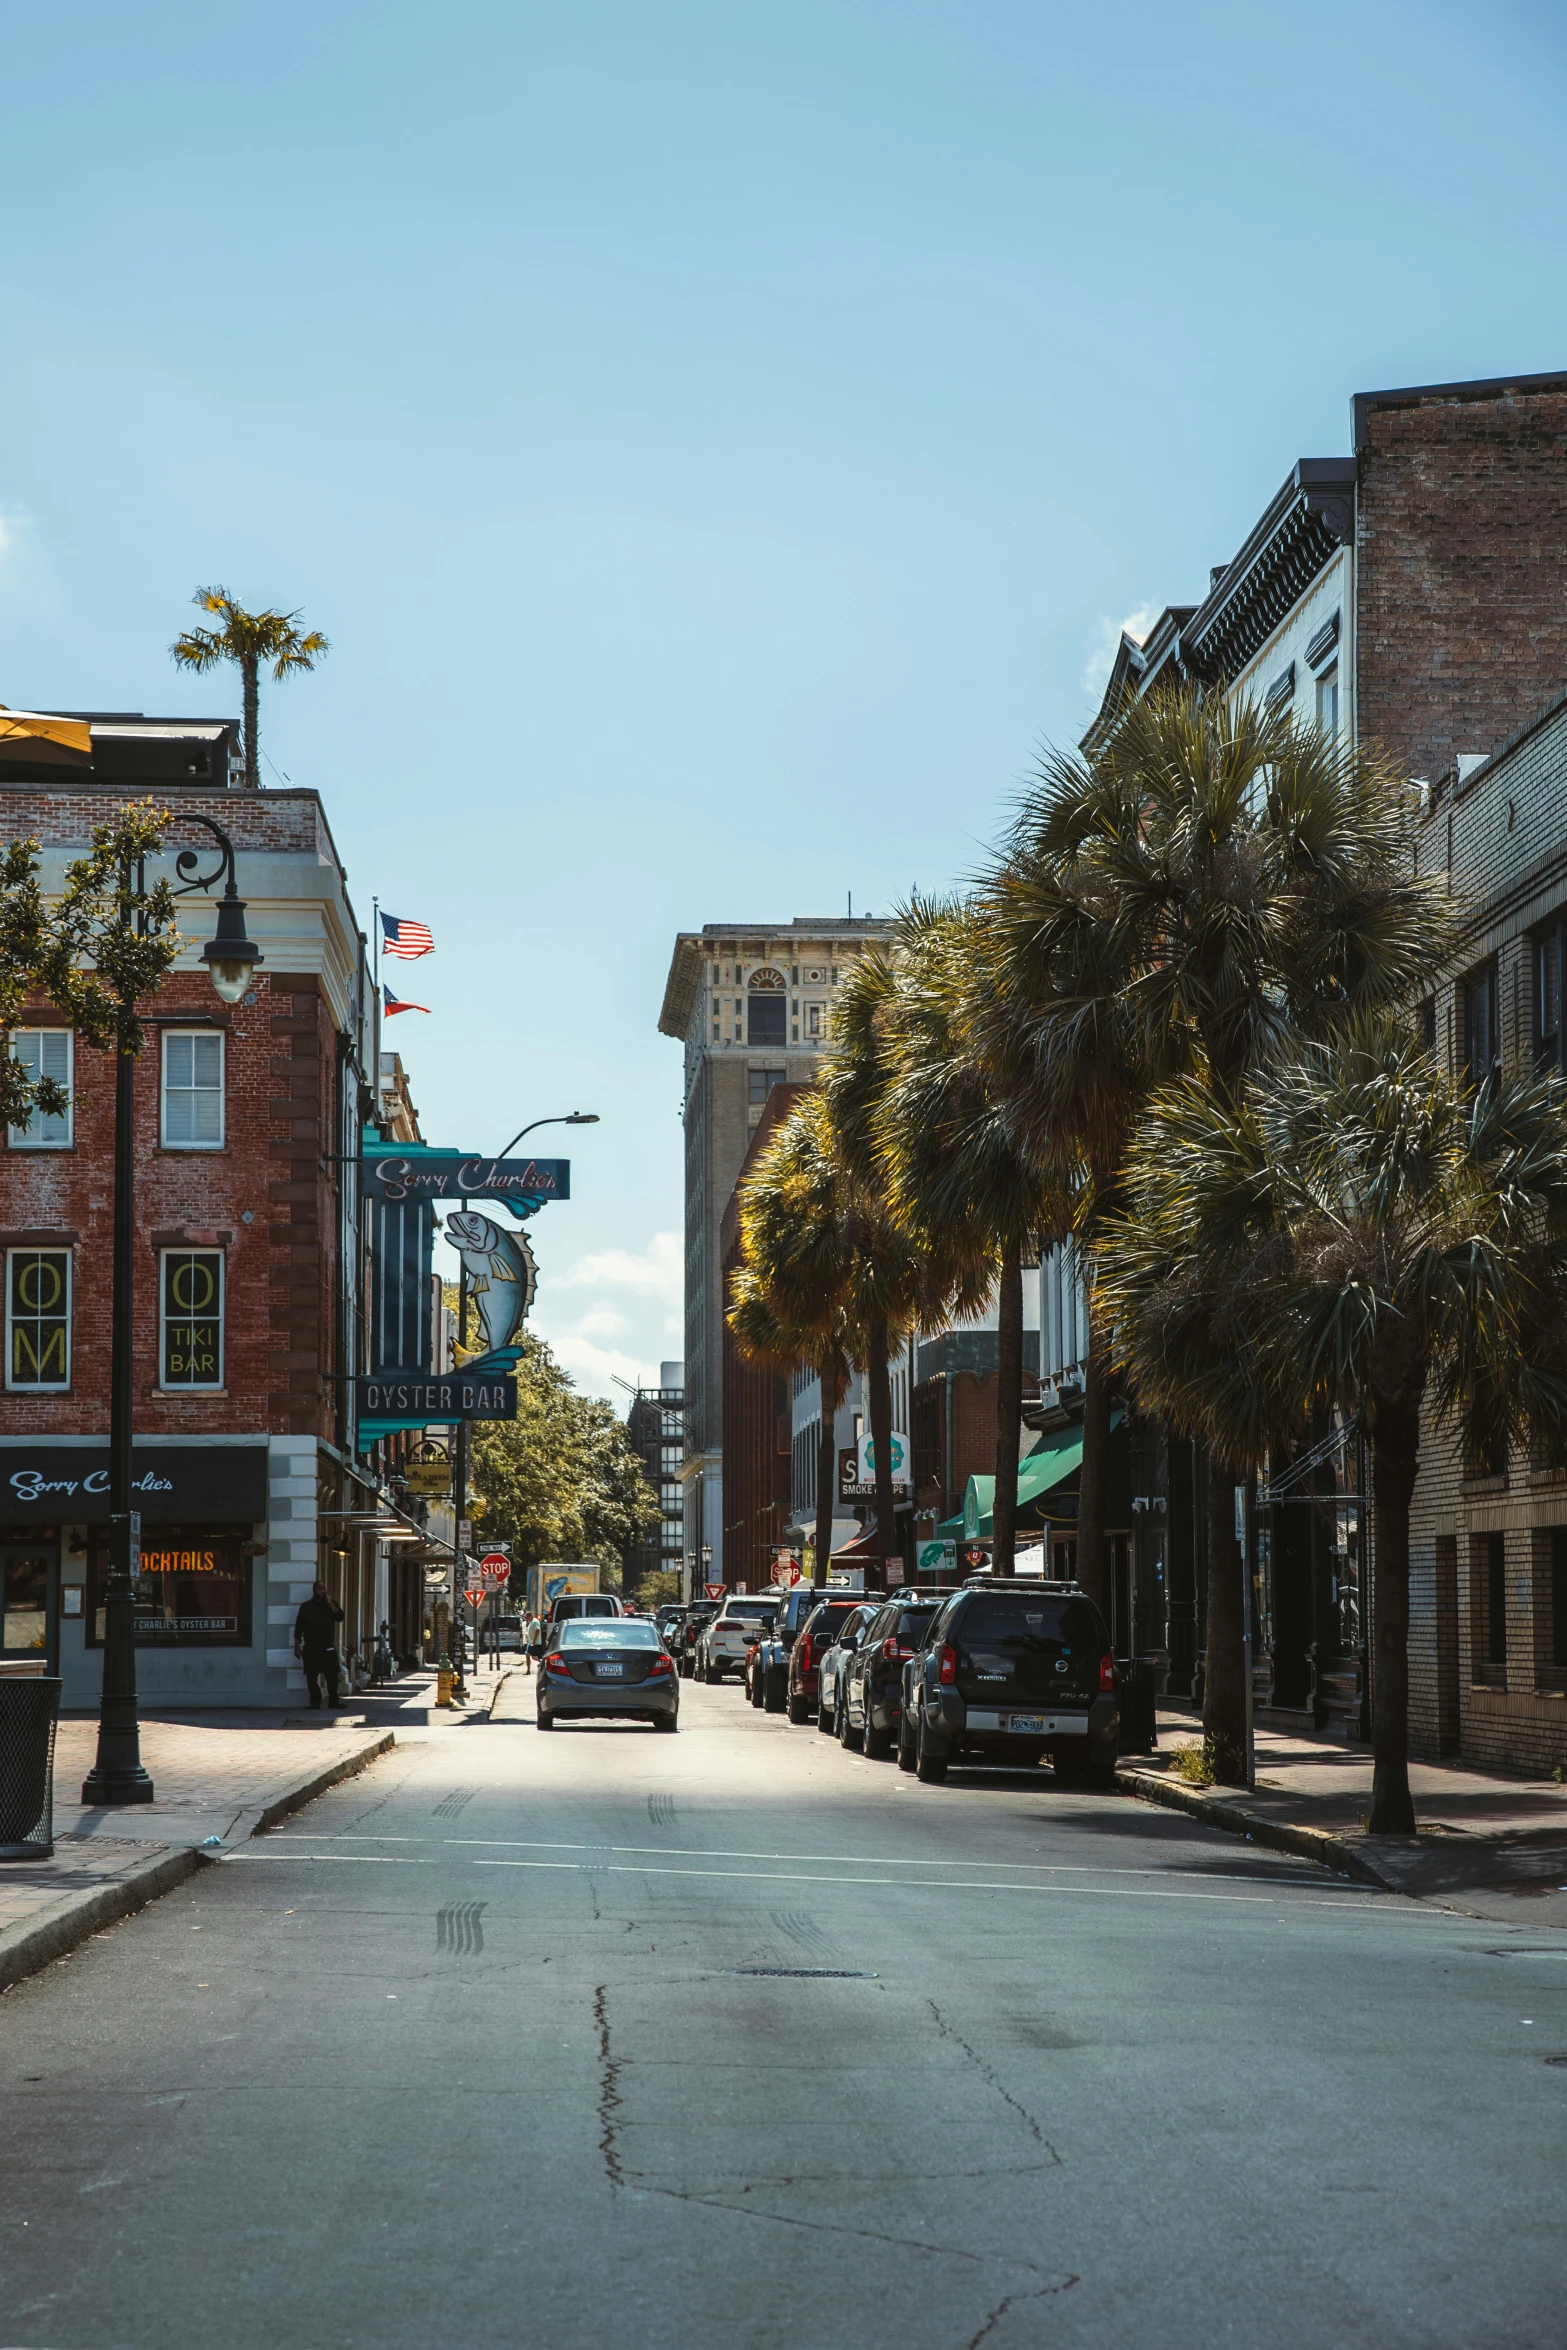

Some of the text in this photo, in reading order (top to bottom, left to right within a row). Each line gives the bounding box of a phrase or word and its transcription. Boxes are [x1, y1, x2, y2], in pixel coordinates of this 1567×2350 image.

[375, 1158, 557, 1199] Sorry Charlie's
[18, 1262, 61, 1309] O
[172, 1263, 214, 1310] O
[171, 1328, 212, 1346] TIKI
[14, 1328, 65, 1375] M
[170, 1354, 214, 1372] BAR
[367, 1385, 506, 1409] OYSTER BAR
[9, 1470, 173, 1501] Sorry Crlie's
[842, 1485, 873, 1494] SMOKE
[139, 1551, 214, 1572] OCKTAILS
[482, 1562, 508, 1575] STOP
[180, 1619, 209, 1629] OYSTER
[210, 1619, 226, 1629] BAR
